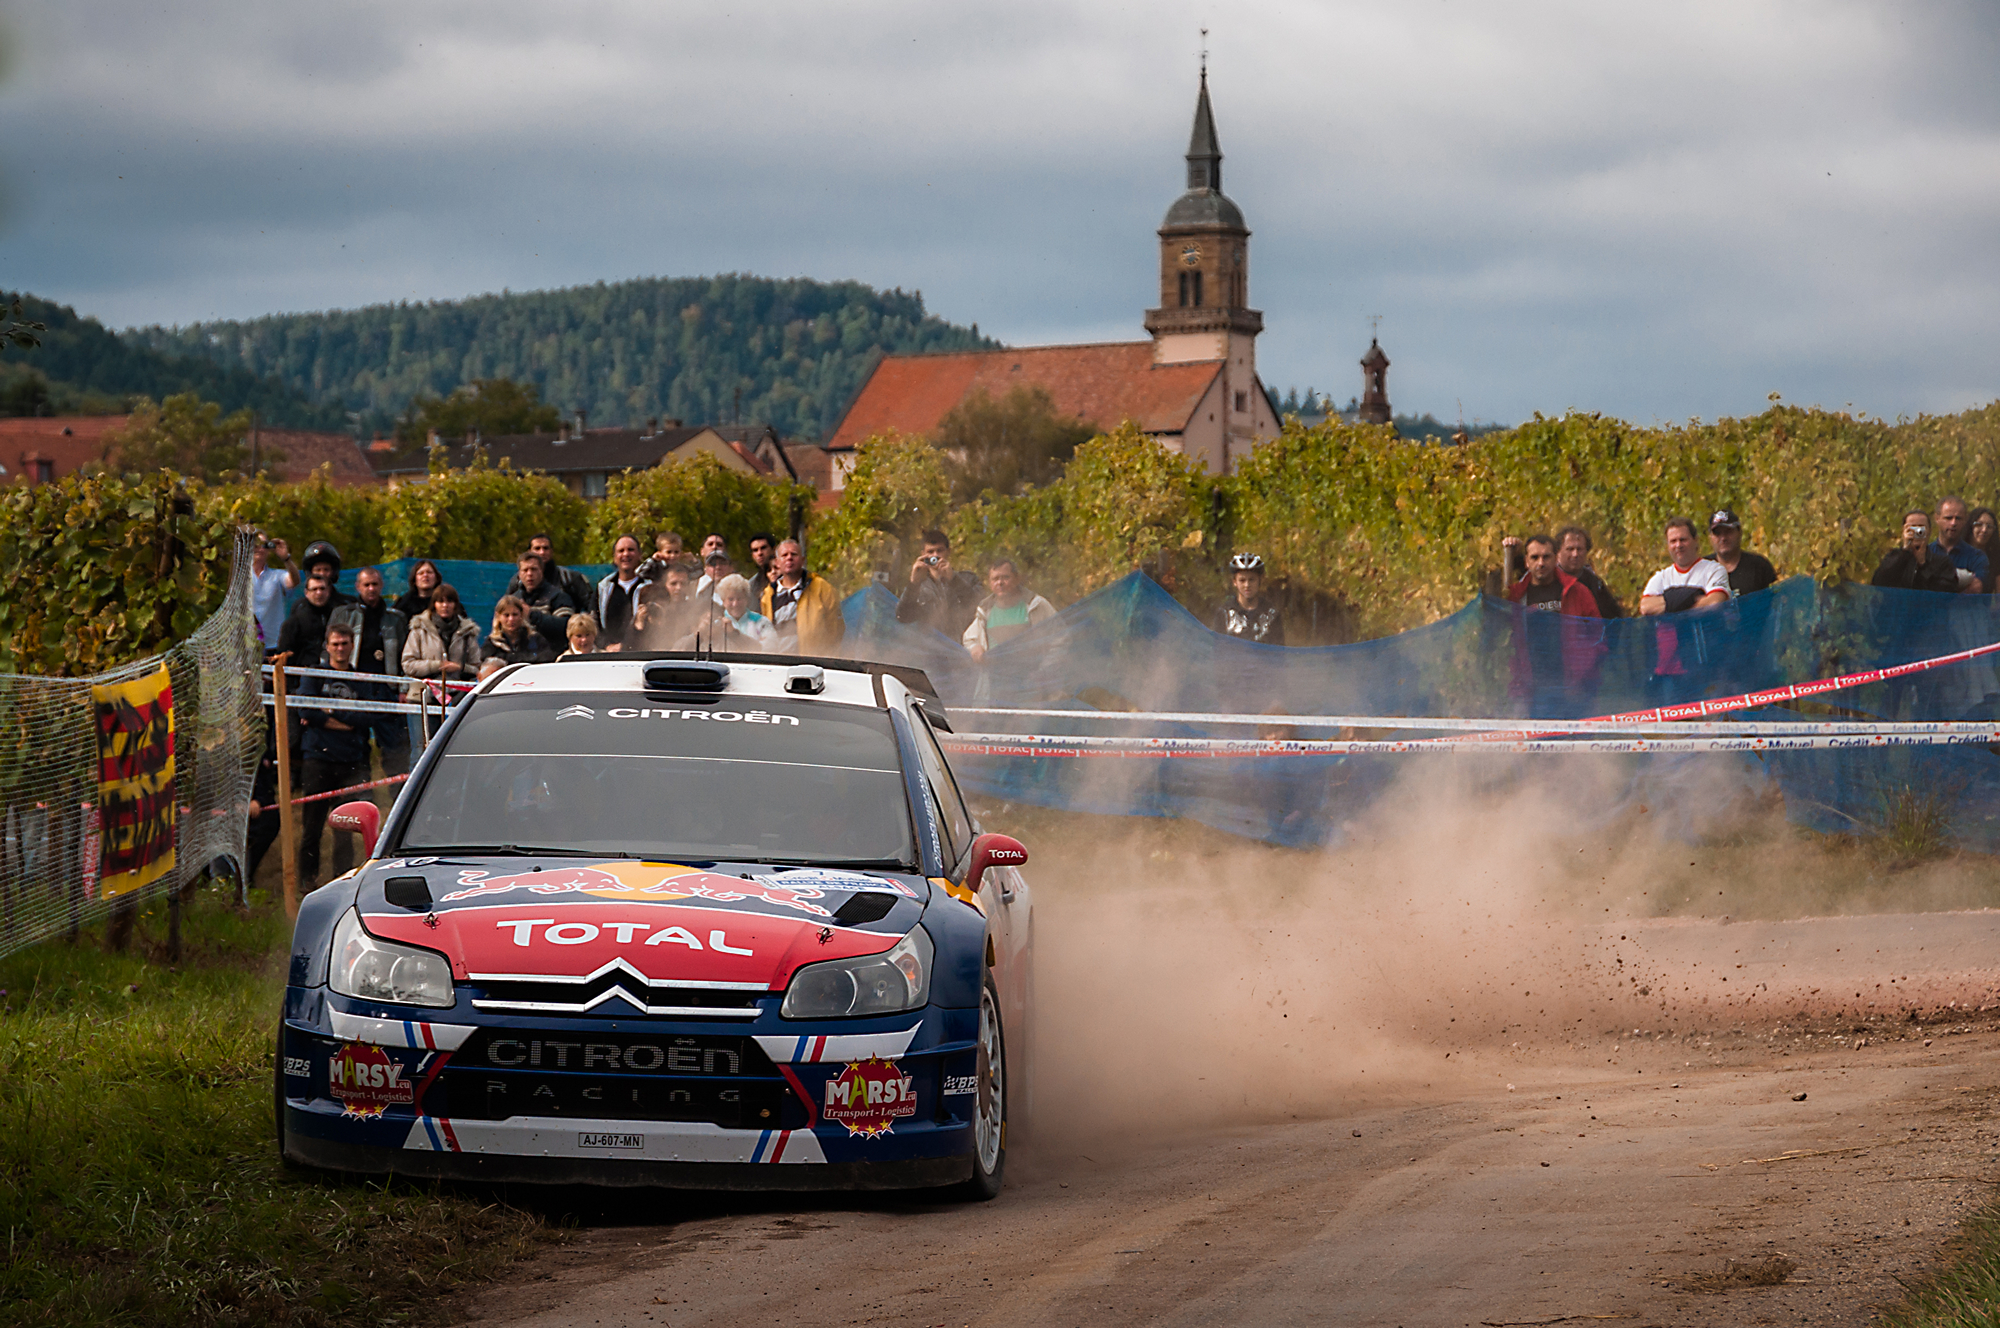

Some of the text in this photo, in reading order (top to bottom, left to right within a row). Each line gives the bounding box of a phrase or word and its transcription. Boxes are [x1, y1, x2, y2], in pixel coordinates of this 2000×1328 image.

[1617, 713, 1656, 722] TOTAL
[1662, 706, 1701, 718] TOTAL
[1706, 699, 1746, 711] TOTAL
[1750, 691, 1790, 703] TOTAL
[1795, 682, 1834, 694] TOTAL
[1840, 673, 1879, 685] TOTAL
[1710, 739, 1814, 749] Crédit Mutuel
[1829, 736, 1933, 747] Crédit Mutuel
[1948, 734, 1989, 744] Crédit
[992, 745, 1029, 753] TOTAL
[1226, 741, 1333, 751] Crédit Mtuel
[1348, 743, 1389, 751] Crédit
[1590, 742, 1694, 751] Crédit Mutuel
[332, 813, 361, 824] TOTAL
[988, 849, 1024, 858] TOTAL
[496, 918, 754, 957] TOTAL
[287, 1057, 311, 1071] BPS
[372, 1091, 412, 1102] Logistics
[826, 1107, 874, 1119] Transport
[881, 1106, 916, 1119] Logistics
[583, 1134, 641, 1148] AJ-607-MN
